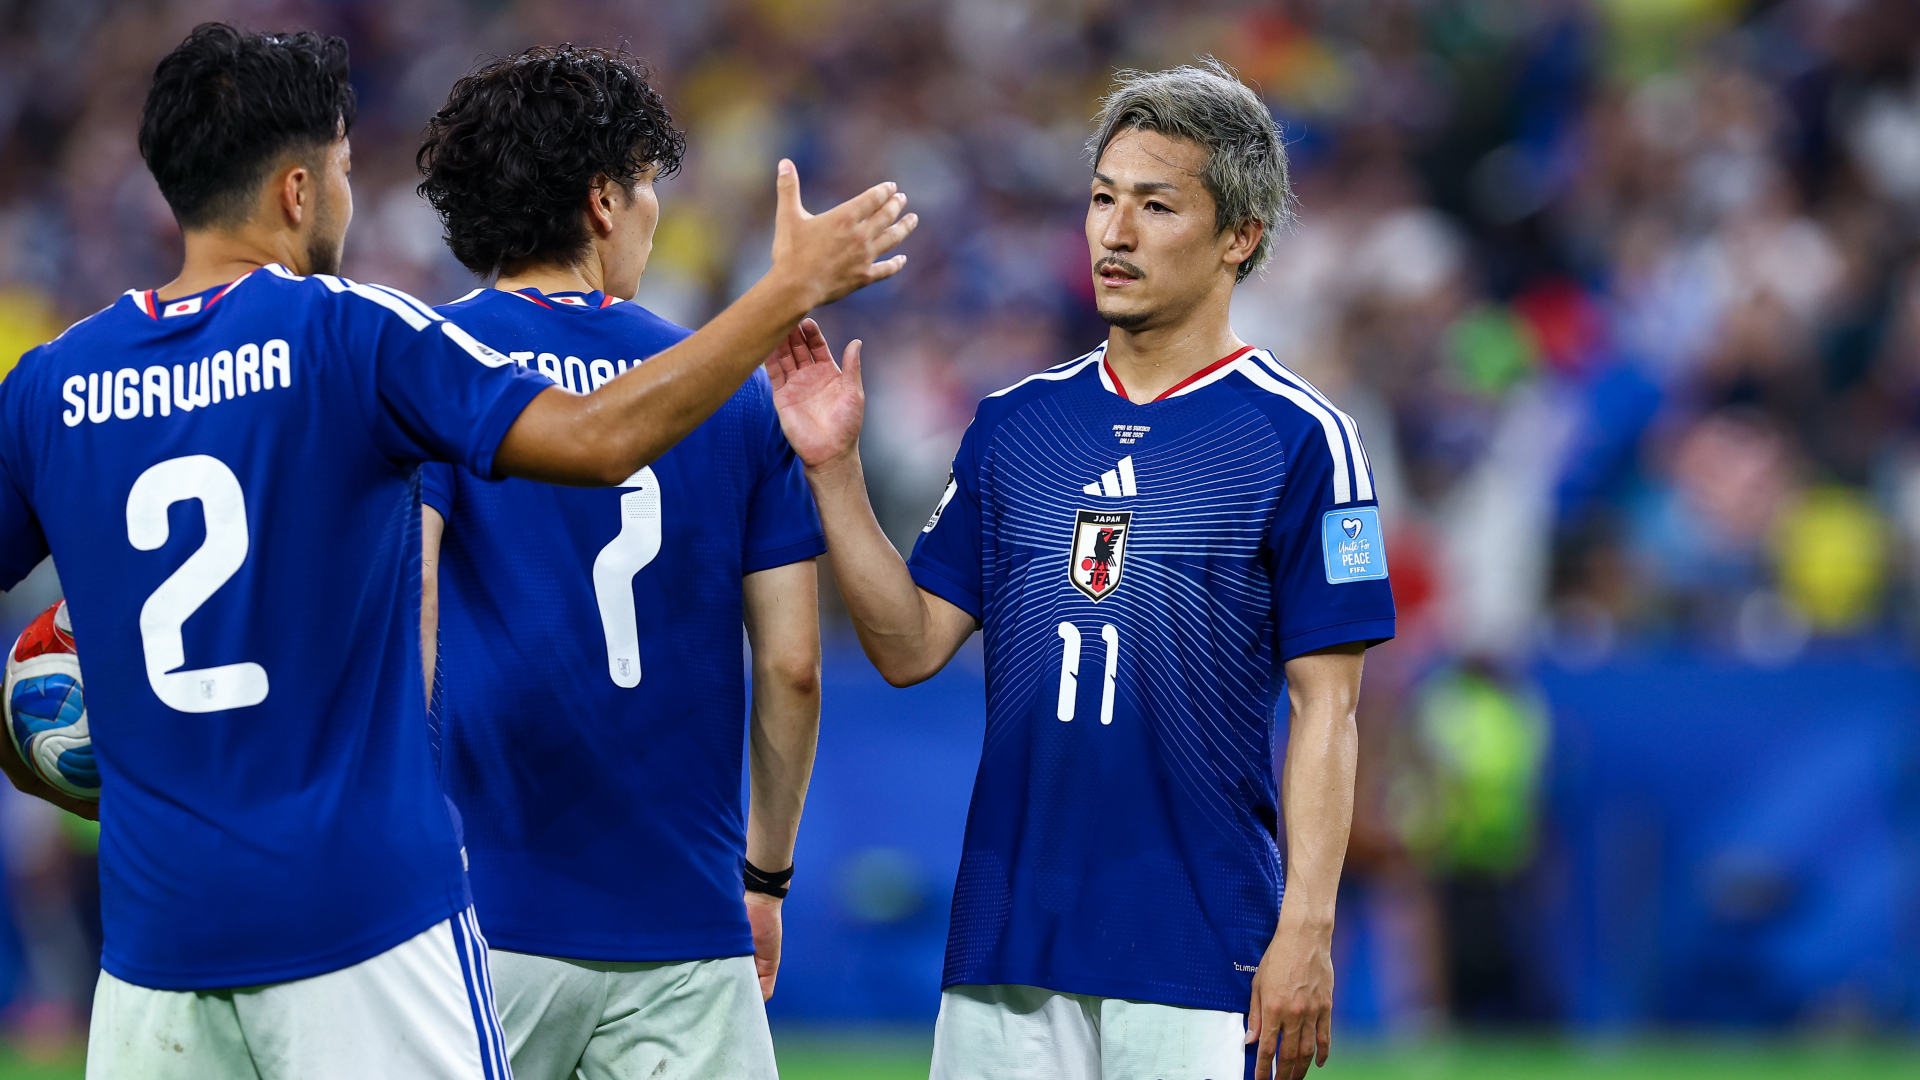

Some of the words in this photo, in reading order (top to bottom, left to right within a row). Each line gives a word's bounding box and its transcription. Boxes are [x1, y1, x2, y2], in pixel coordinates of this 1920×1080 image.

[63, 339, 291, 427] SUGAWARA
[1093, 515, 1121, 523] JAPAN
[1338, 541, 1359, 554] Unite
[1359, 539, 1371, 552] For
[1342, 552, 1371, 566] PEACE
[1349, 566, 1366, 574] FIFA
[127, 455, 268, 713] 2
[1085, 572, 1111, 586] JFA
[1057, 621, 1119, 725] 11
